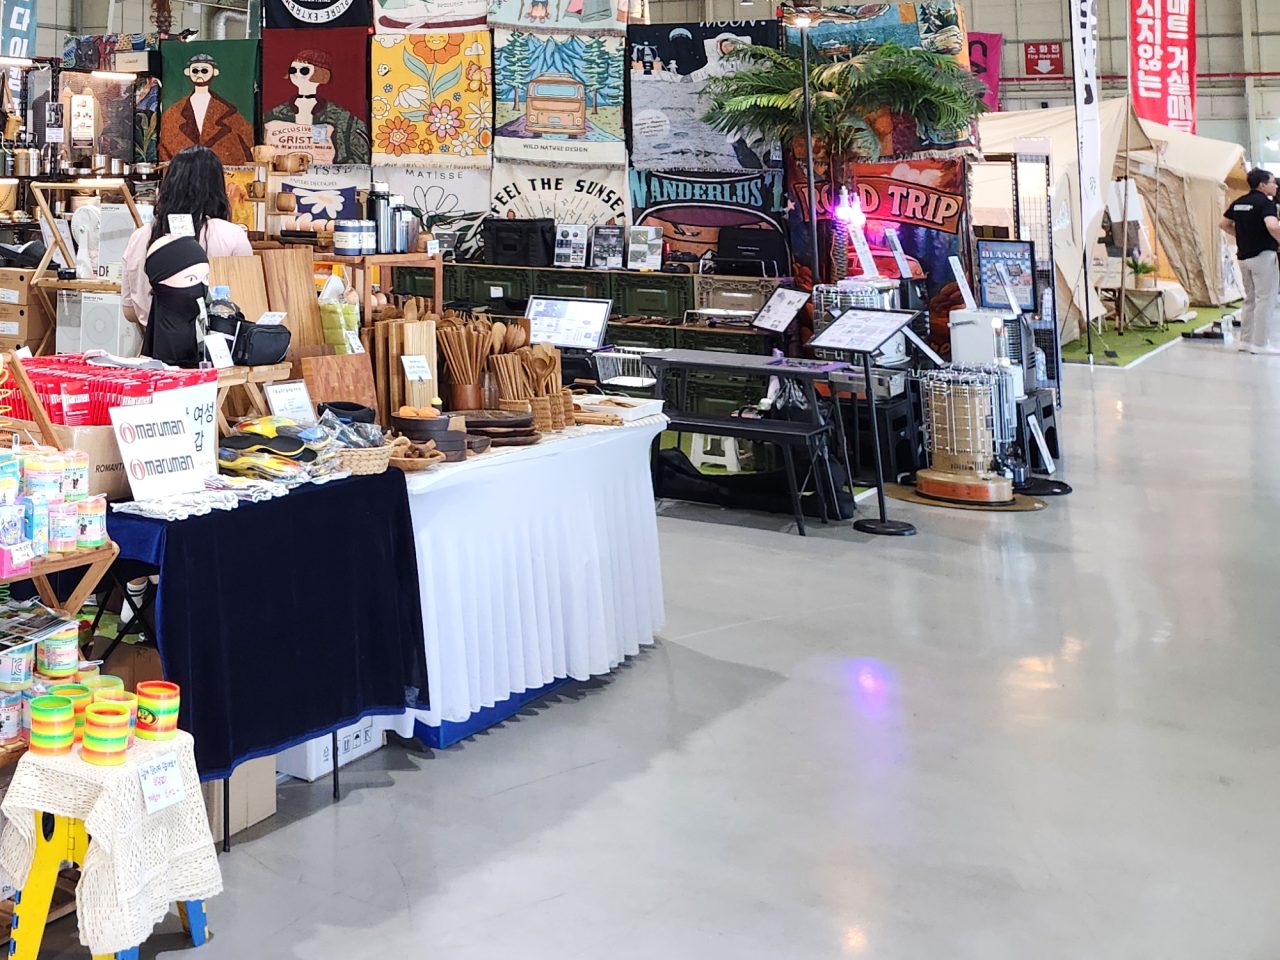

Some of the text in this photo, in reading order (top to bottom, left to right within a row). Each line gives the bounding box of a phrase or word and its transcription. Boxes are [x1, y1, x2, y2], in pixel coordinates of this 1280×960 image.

[271, 126, 311, 136] EXCLUSIVE
[405, 169, 463, 180] MATISSE
[491, 182, 521, 214] FEEL
[527, 177, 564, 191] THE
[801, 184, 959, 225] ROD TRIP
[982, 251, 1030, 259] BLANKET
[193, 401, 214, 425] 여성
[135, 419, 186, 440] maruman
[144, 455, 195, 476] maruman
